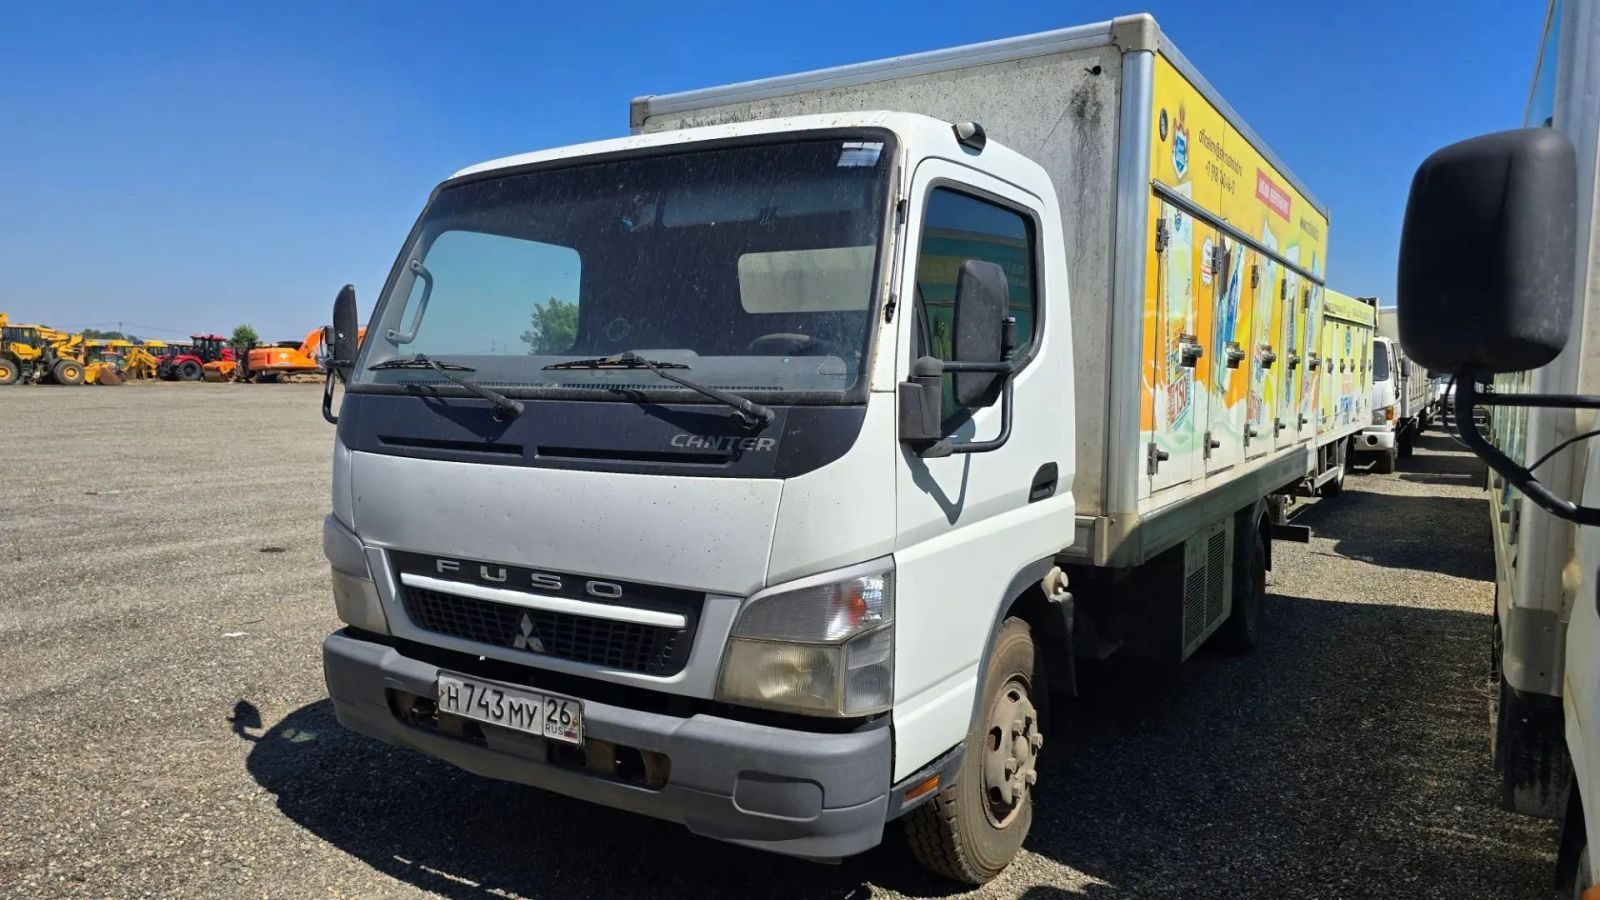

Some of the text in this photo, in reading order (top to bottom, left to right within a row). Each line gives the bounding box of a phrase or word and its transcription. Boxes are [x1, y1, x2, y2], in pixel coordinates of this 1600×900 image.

[671, 434, 776, 451] CANTER
[436, 558, 622, 599] FUSO
[547, 698, 571, 726] 26
[545, 723, 564, 736] RUS
